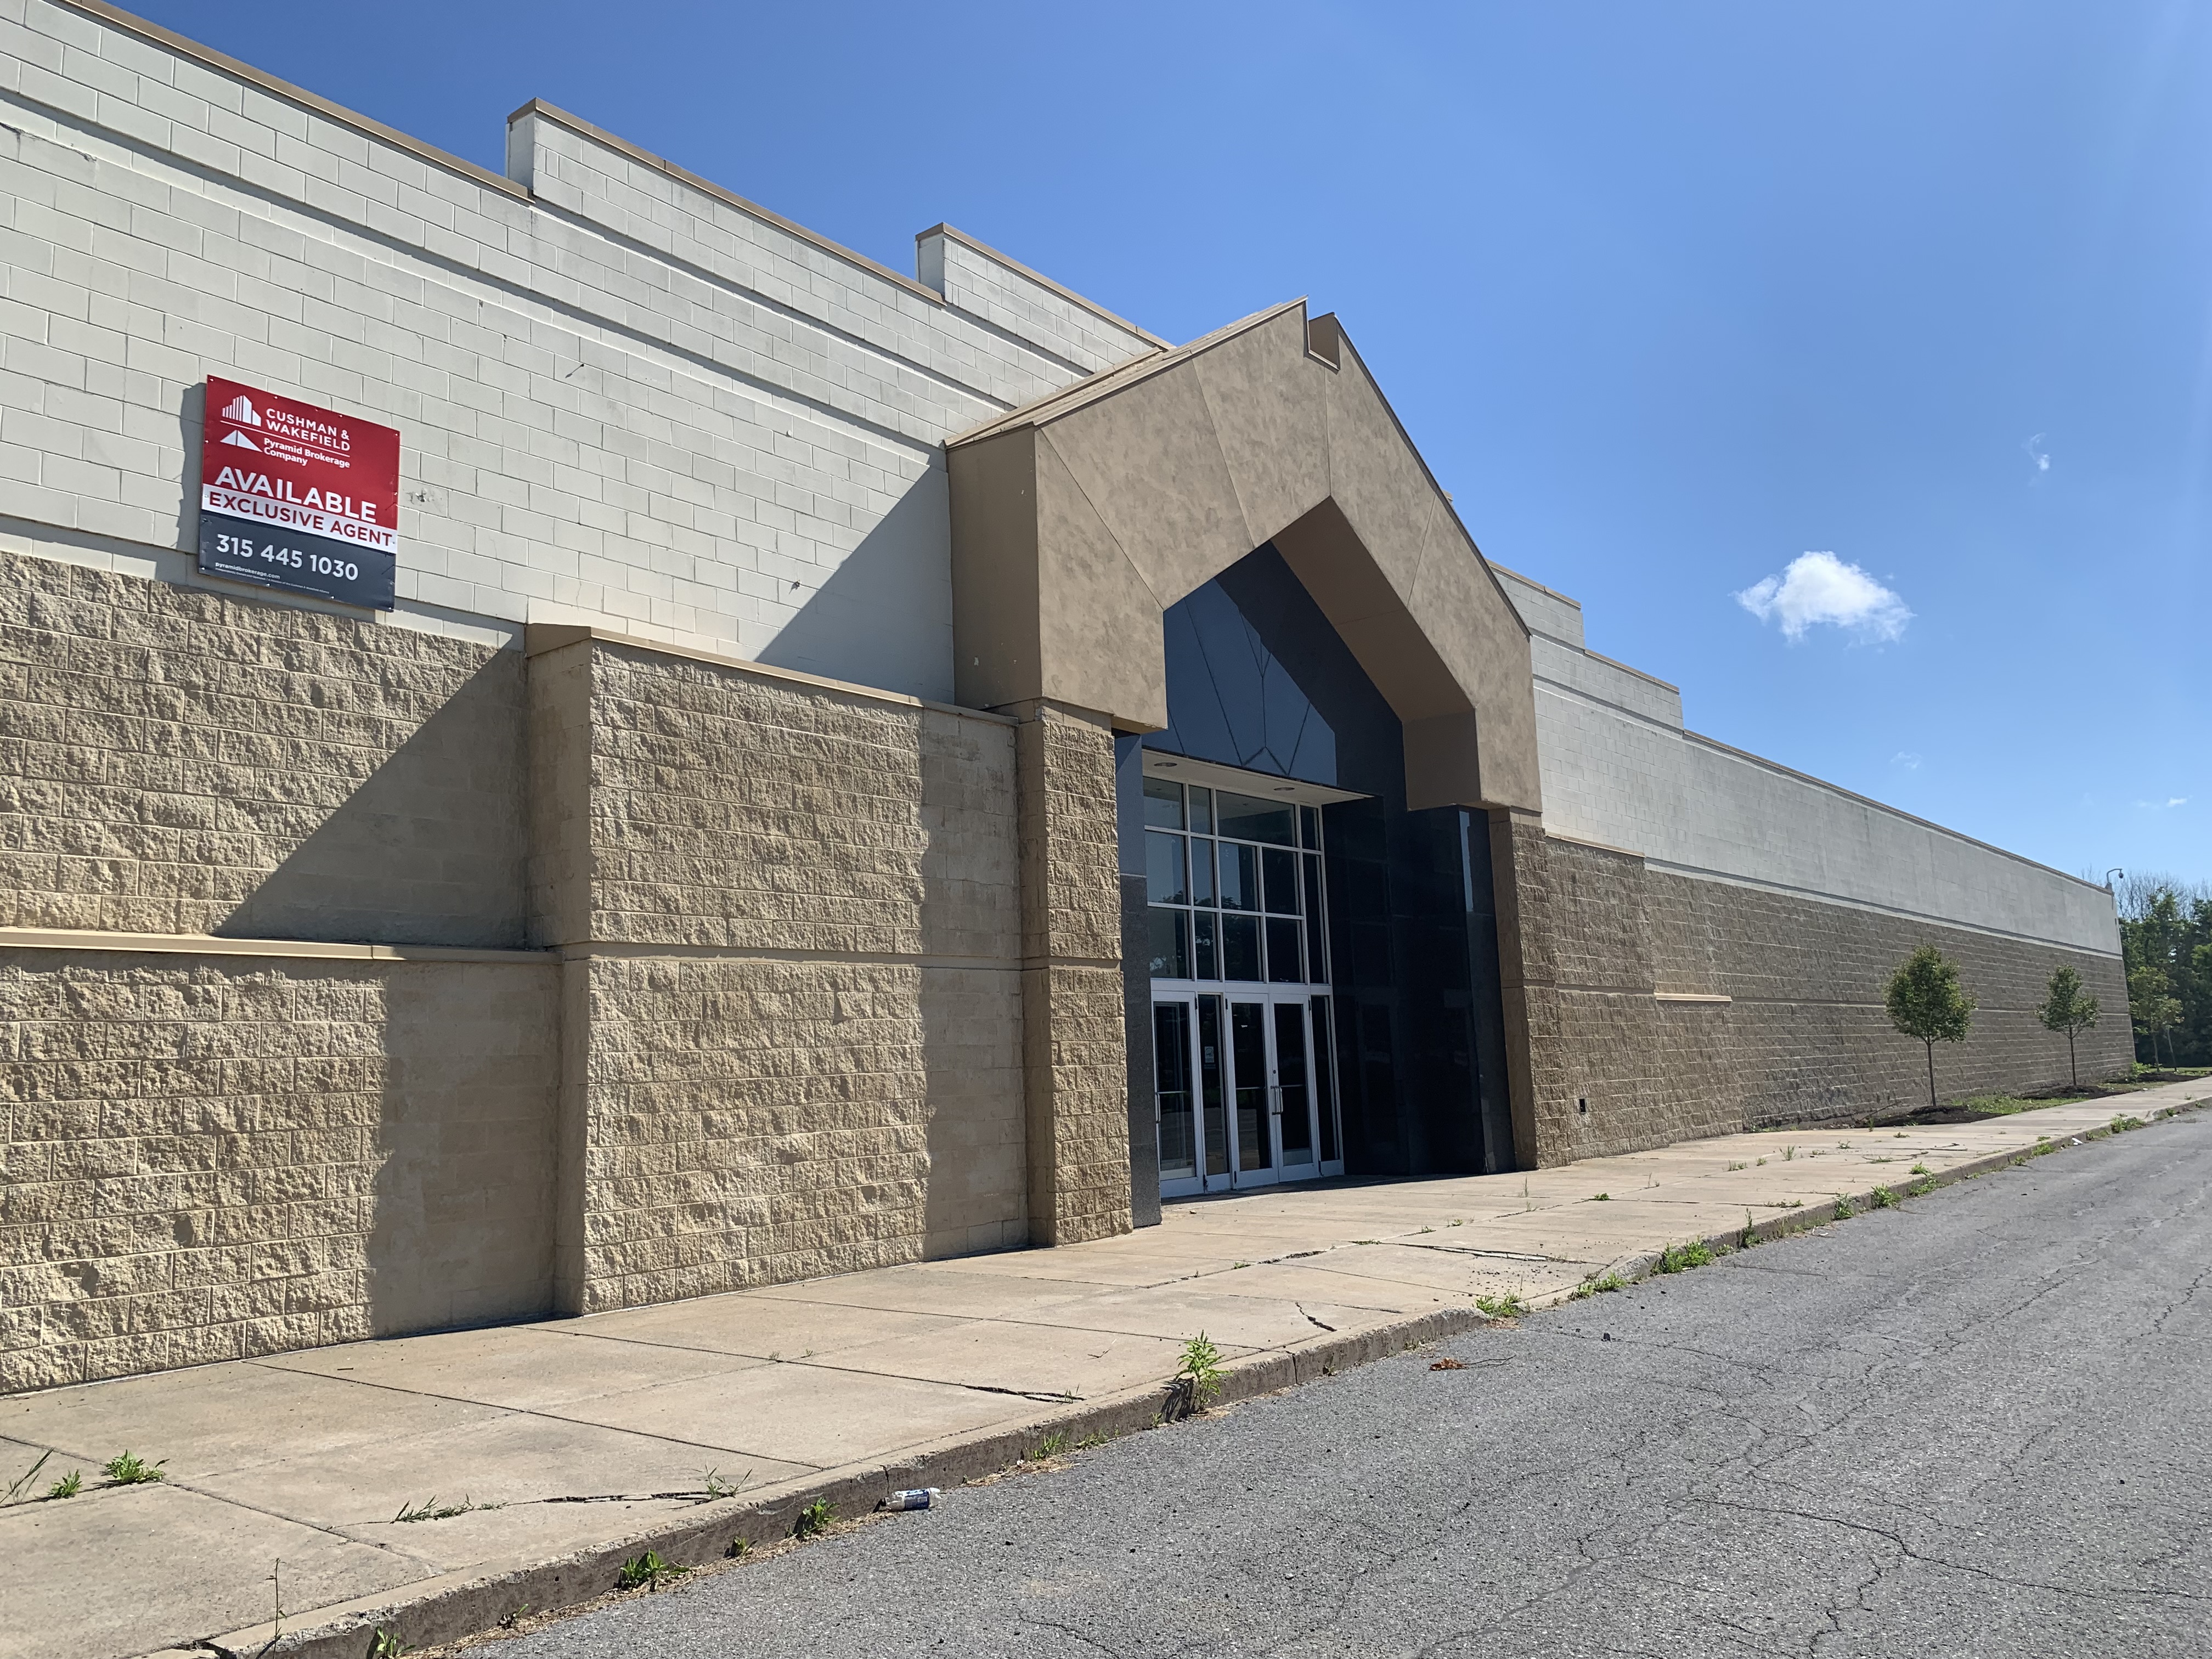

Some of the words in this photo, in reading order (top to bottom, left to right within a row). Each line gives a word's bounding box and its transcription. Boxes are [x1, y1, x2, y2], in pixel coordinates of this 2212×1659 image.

[266, 408, 337, 437] CUSHMAN
[341, 430, 350, 441] &
[266, 419, 351, 451] WAKEFIELD
[264, 438, 302, 455] Pyramid
[304, 449, 351, 468] Brokerage
[264, 447, 308, 466] Company
[215, 466, 377, 523] AVAILABLE
[209, 491, 324, 531] EXCLUSIVE
[330, 521, 392, 546] AGENT
[215, 562, 280, 580] pyramidbrokerage.com
[216, 534, 253, 558] 315
[260, 545, 303, 568] 445
[310, 555, 359, 581] 1030
